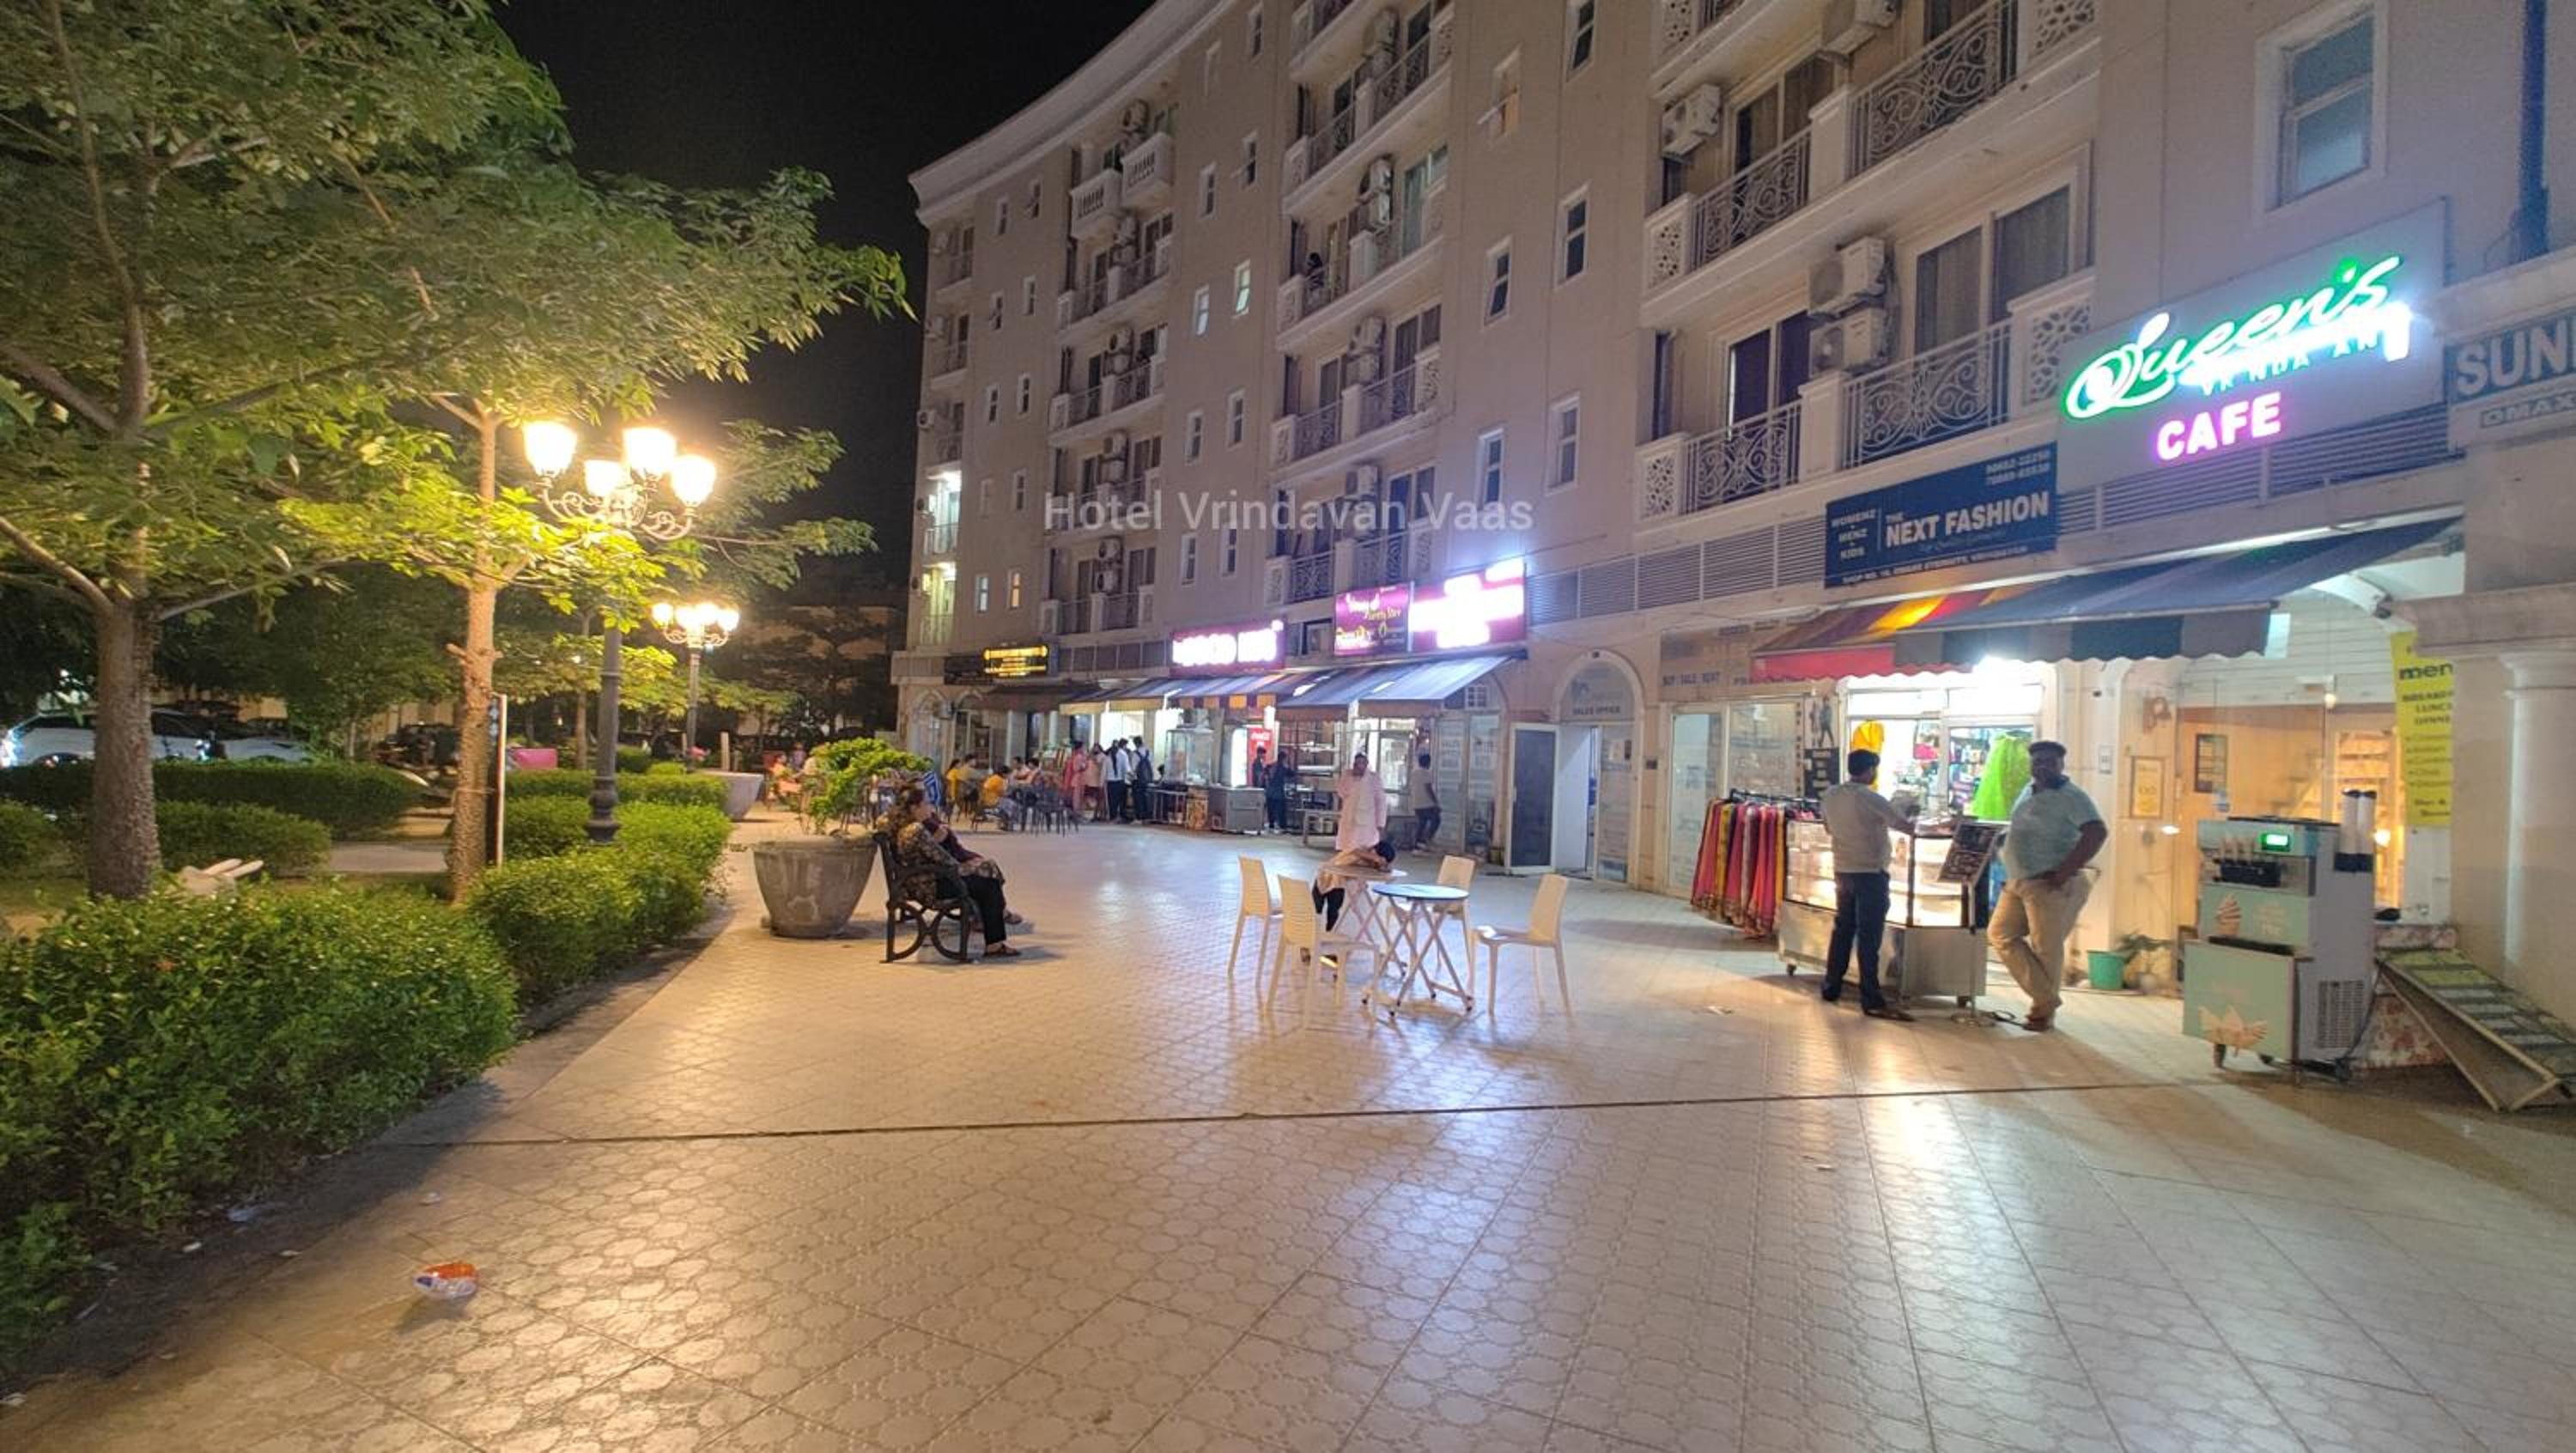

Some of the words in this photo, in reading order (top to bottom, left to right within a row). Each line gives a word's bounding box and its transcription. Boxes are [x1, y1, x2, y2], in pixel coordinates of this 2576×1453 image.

[2066, 256, 2401, 418] Queen's
[2457, 314, 2576, 396] SUN
[2158, 391, 2281, 460] CAFE
[1886, 514, 1940, 547] NEXT
[1945, 491, 2049, 536] FASHION
